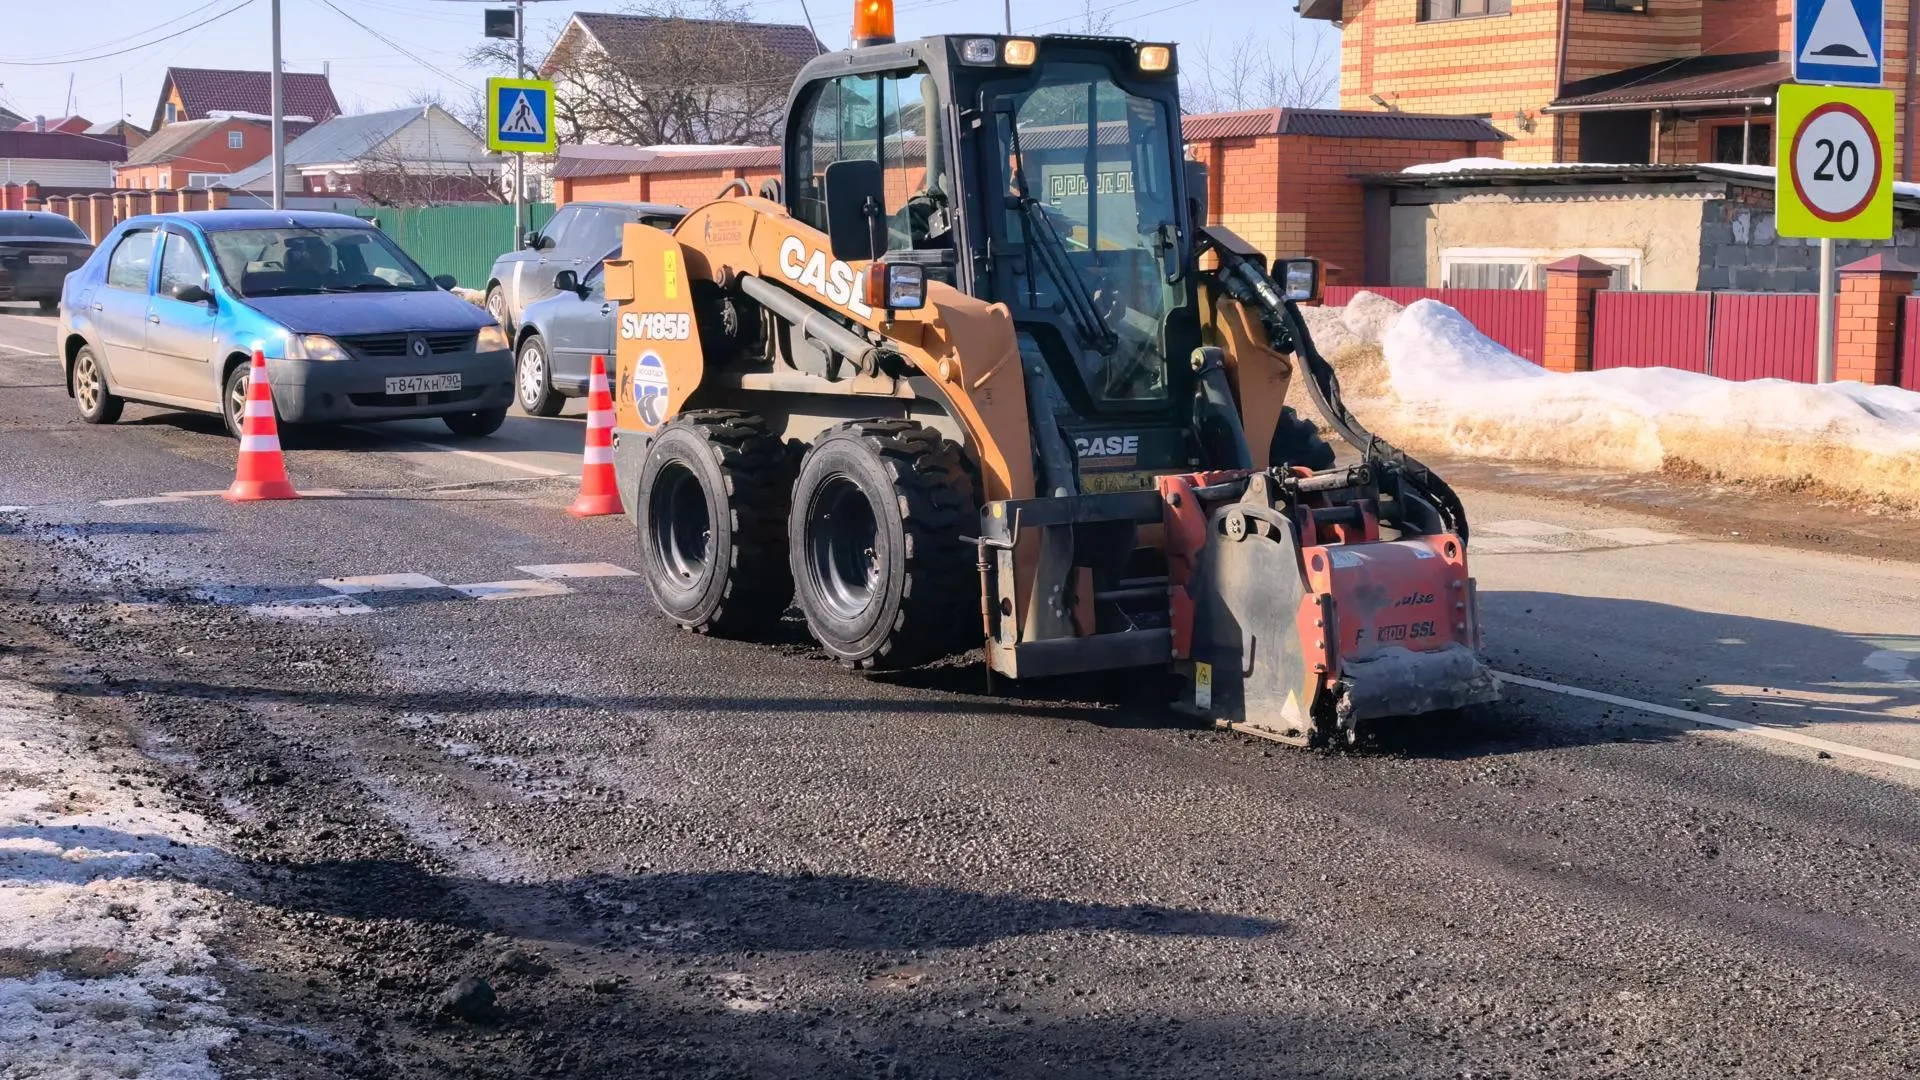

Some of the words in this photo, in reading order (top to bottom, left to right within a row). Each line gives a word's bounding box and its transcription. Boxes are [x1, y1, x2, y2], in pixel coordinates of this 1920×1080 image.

[1813, 139, 1859, 182] 20
[621, 312, 690, 341] SV185B
[1074, 435, 1139, 457] CASE
[1395, 592, 1433, 608] ulse
[1409, 621, 1436, 639] SSL
